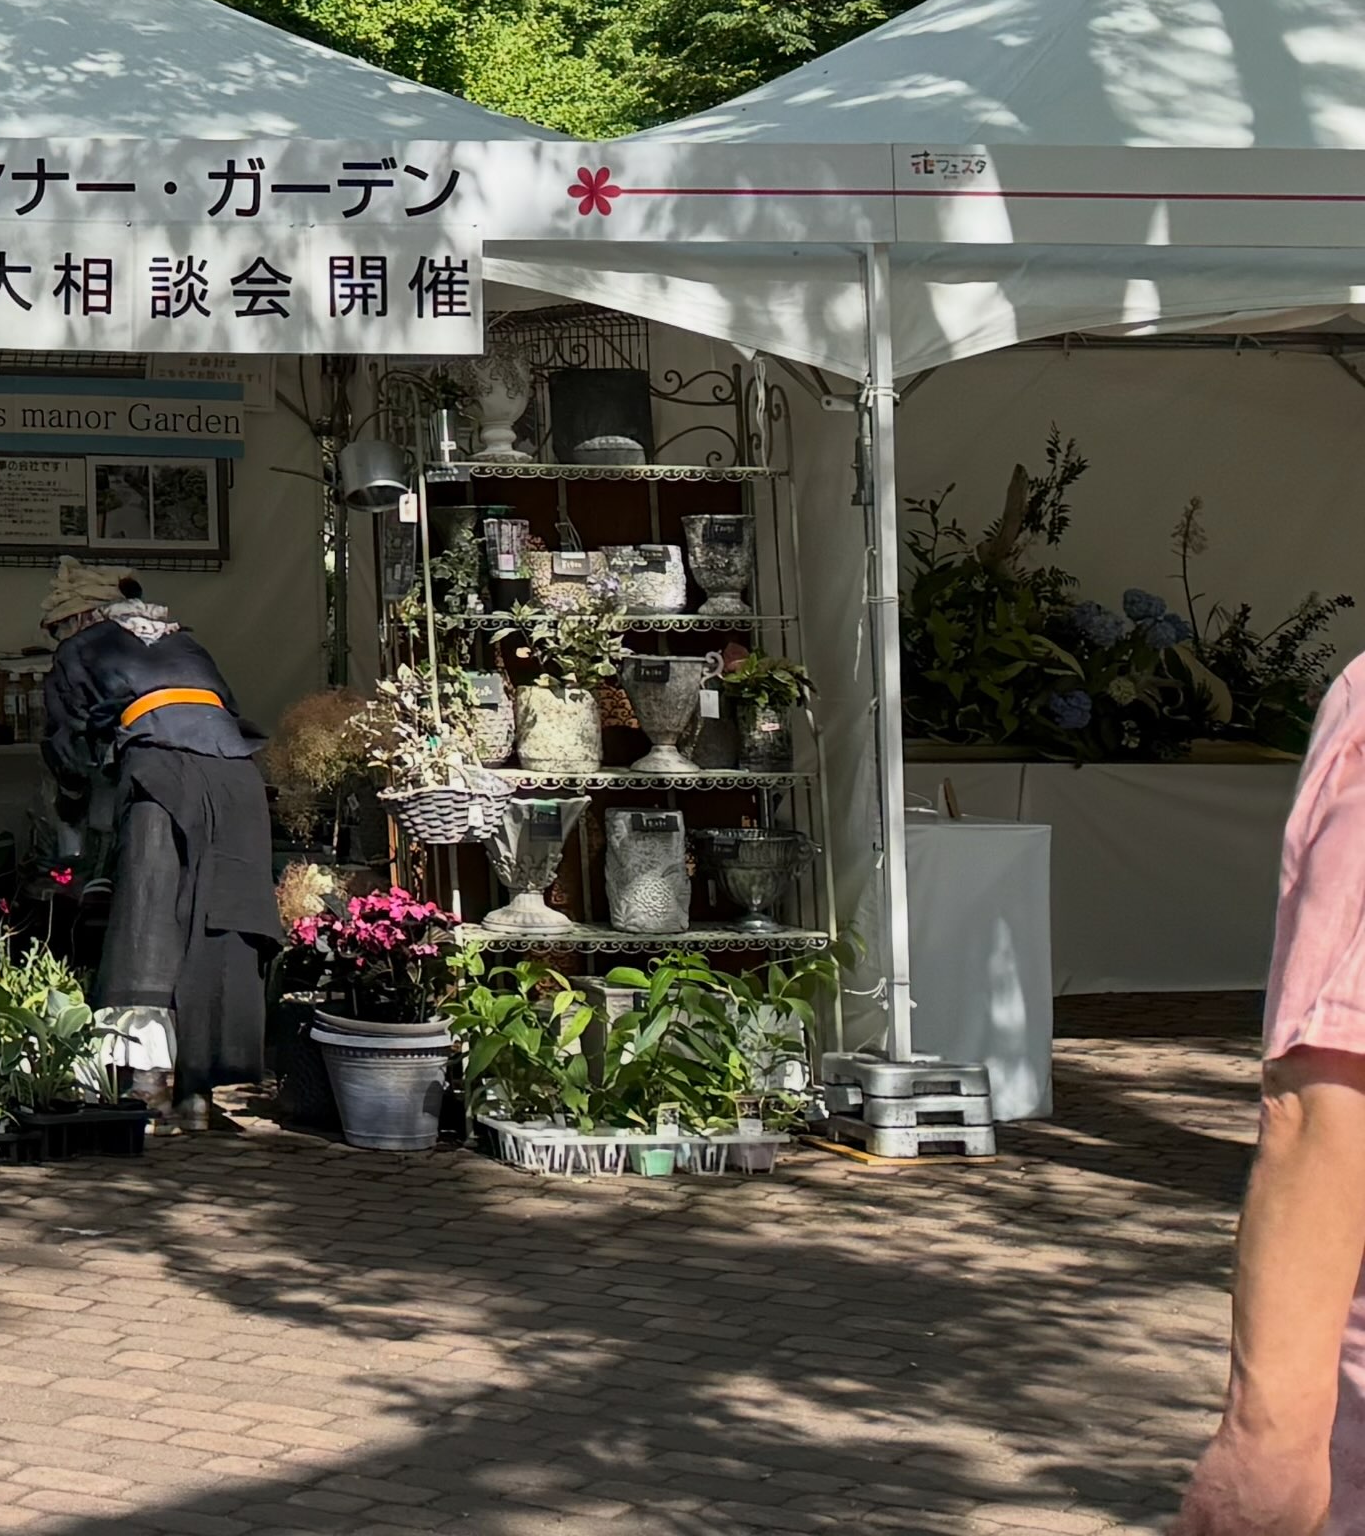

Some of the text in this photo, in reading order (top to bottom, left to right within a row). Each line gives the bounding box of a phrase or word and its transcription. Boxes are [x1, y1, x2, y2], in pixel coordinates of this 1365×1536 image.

[911, 150, 986, 174] 花フェスタ
[22, 407, 116, 430] manor
[128, 403, 241, 434] Garden
